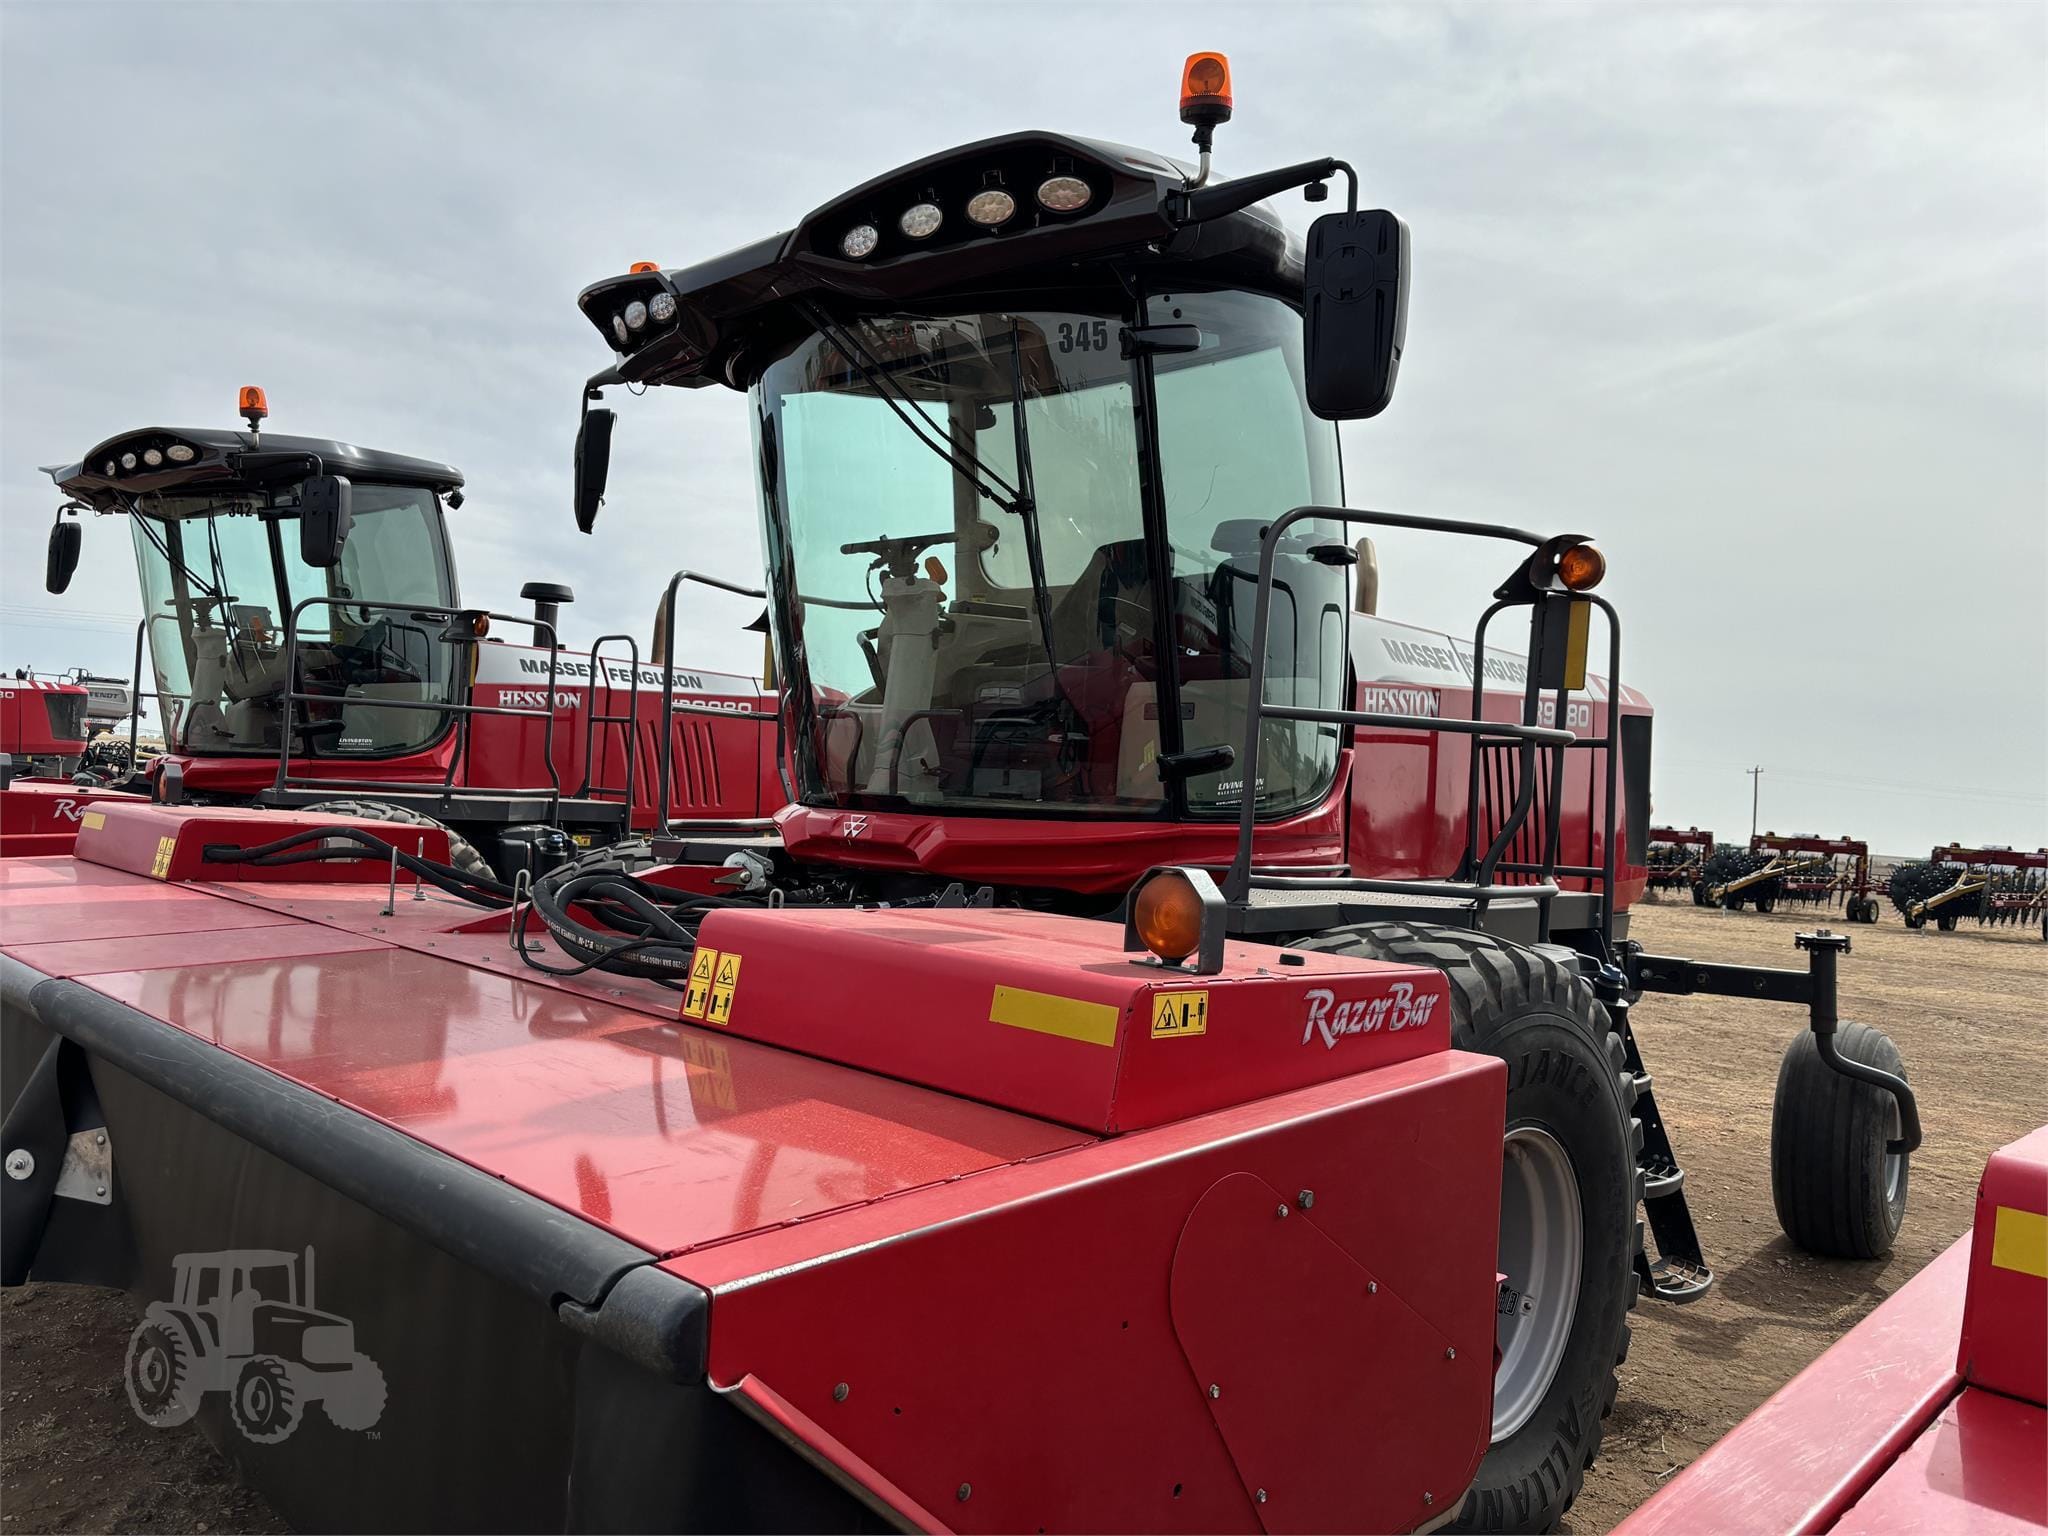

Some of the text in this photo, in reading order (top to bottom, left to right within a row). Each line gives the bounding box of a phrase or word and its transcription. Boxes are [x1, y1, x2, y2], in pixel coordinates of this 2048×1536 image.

[1058, 321, 1108, 354] 345
[1380, 638, 1460, 673] MASSEY
[1364, 687, 1441, 718] HESSTON
